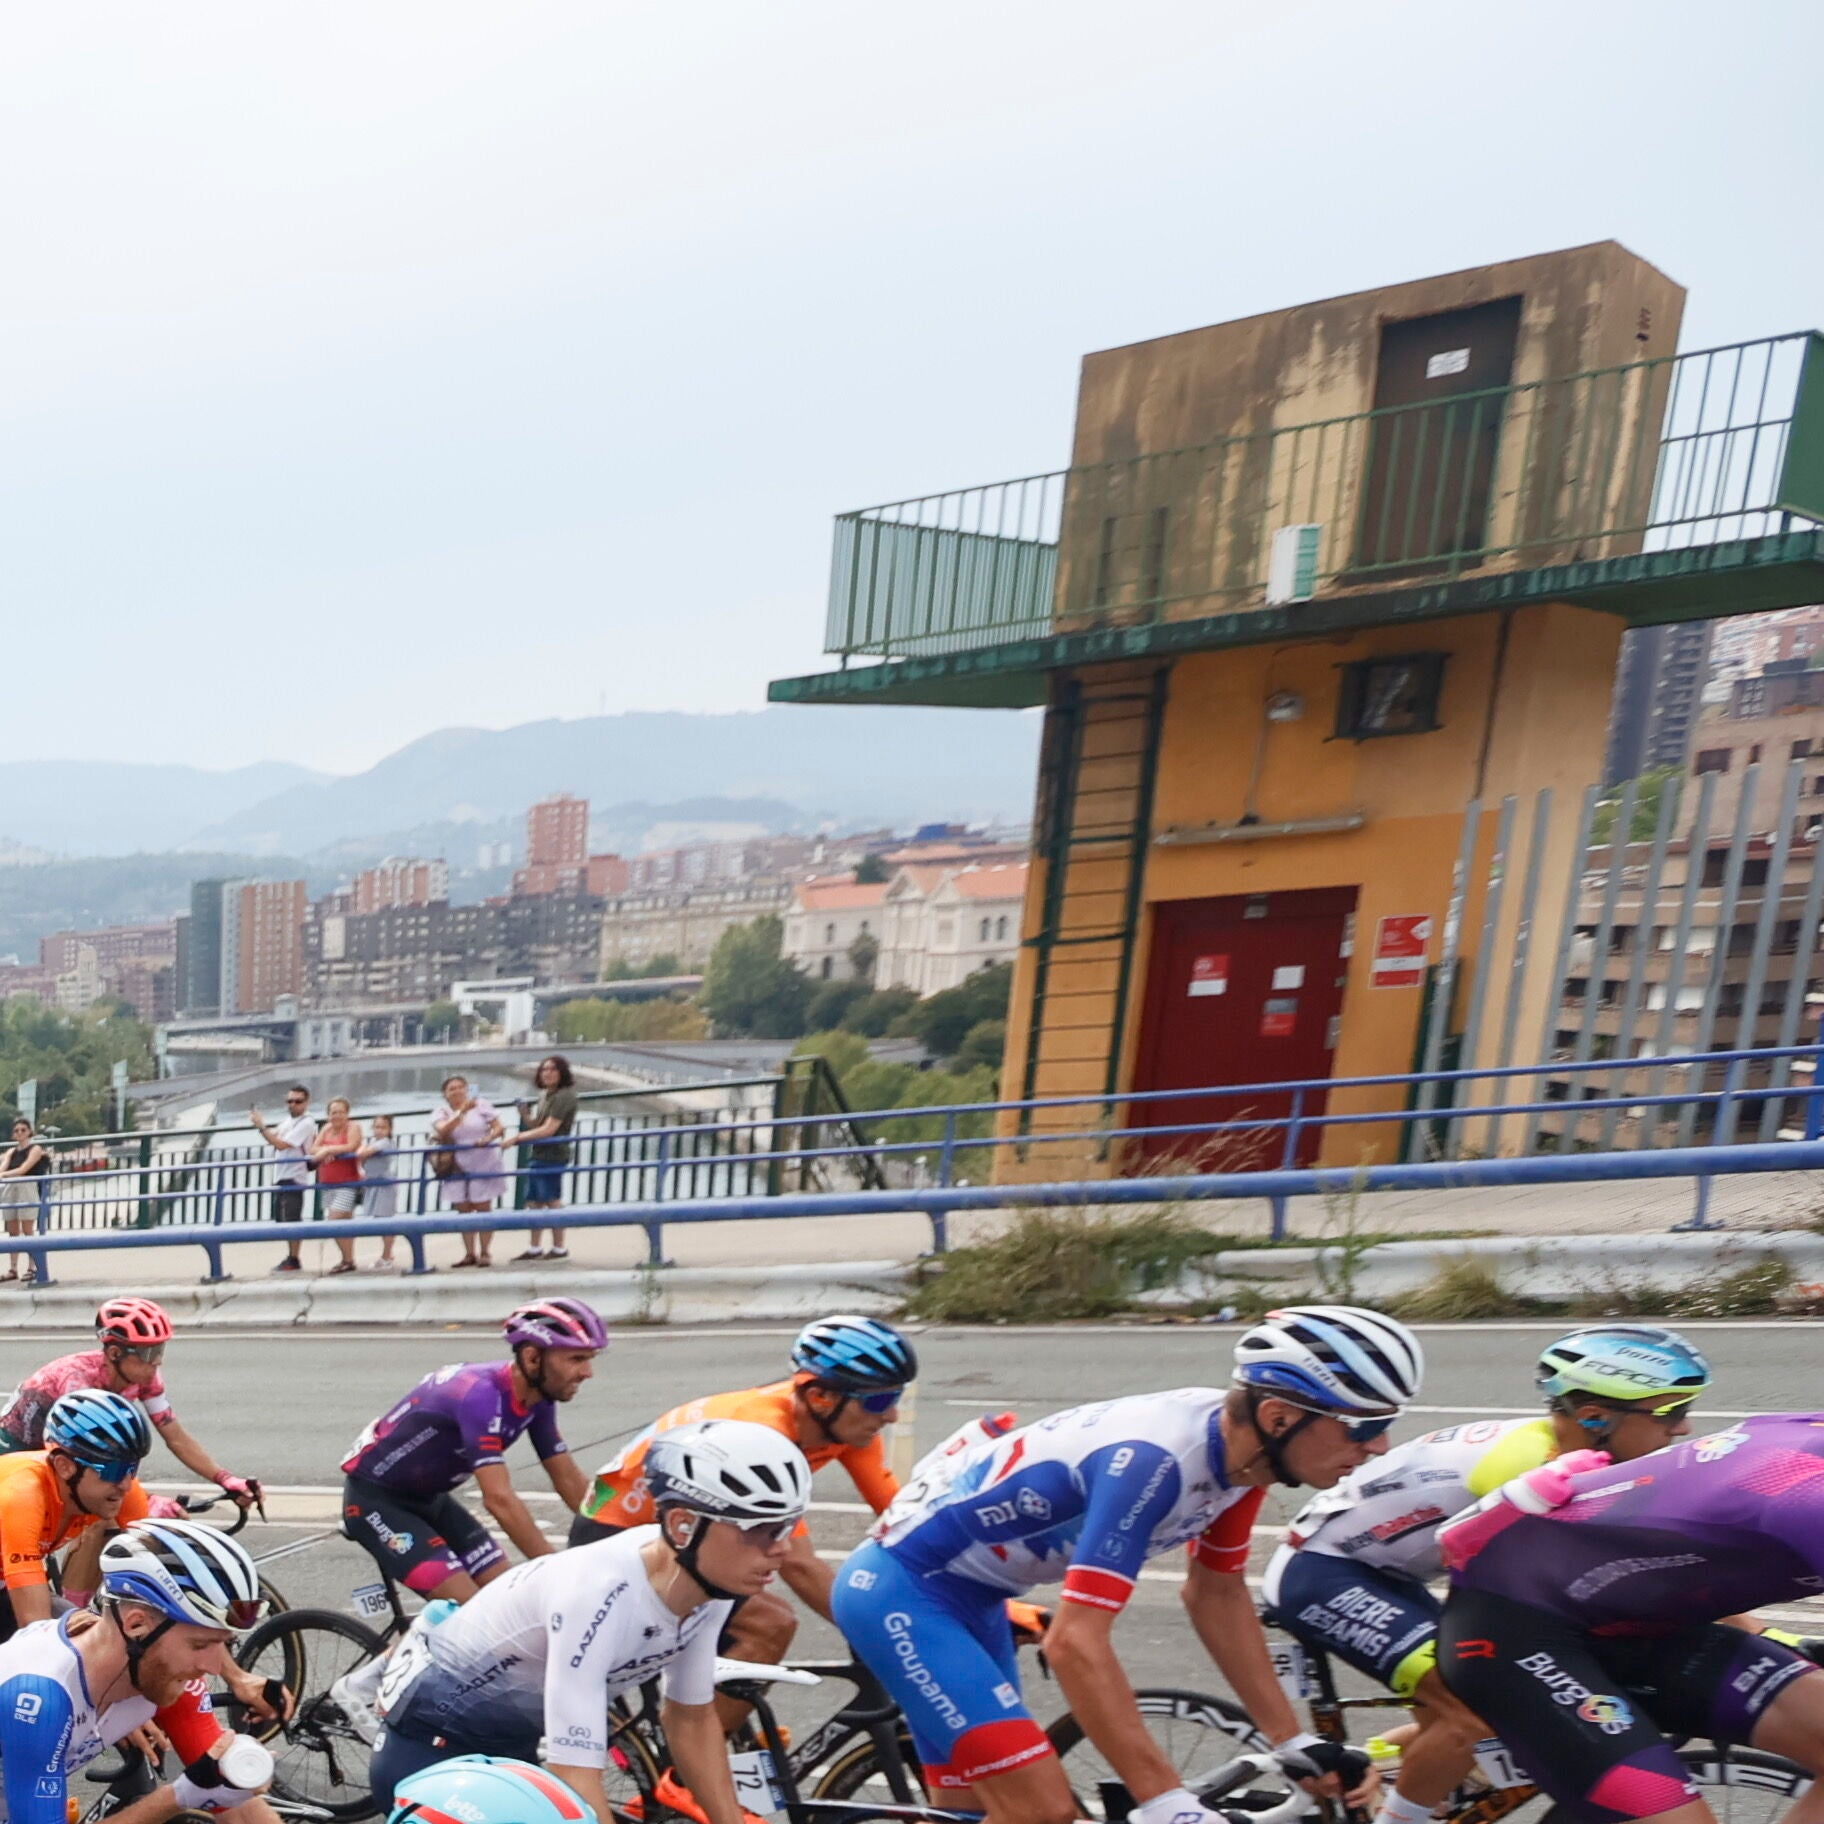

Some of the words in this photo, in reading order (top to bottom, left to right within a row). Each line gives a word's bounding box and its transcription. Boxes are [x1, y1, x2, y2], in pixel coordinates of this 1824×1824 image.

[1583, 1360, 1669, 1388] FORCE
[975, 1500, 1018, 1528] FDJ
[361, 1593, 388, 1614] 196
[1326, 1585, 1405, 1631] BIERE
[1327, 1613, 1391, 1658] AMIS
[882, 1610, 968, 1730] Groupama
